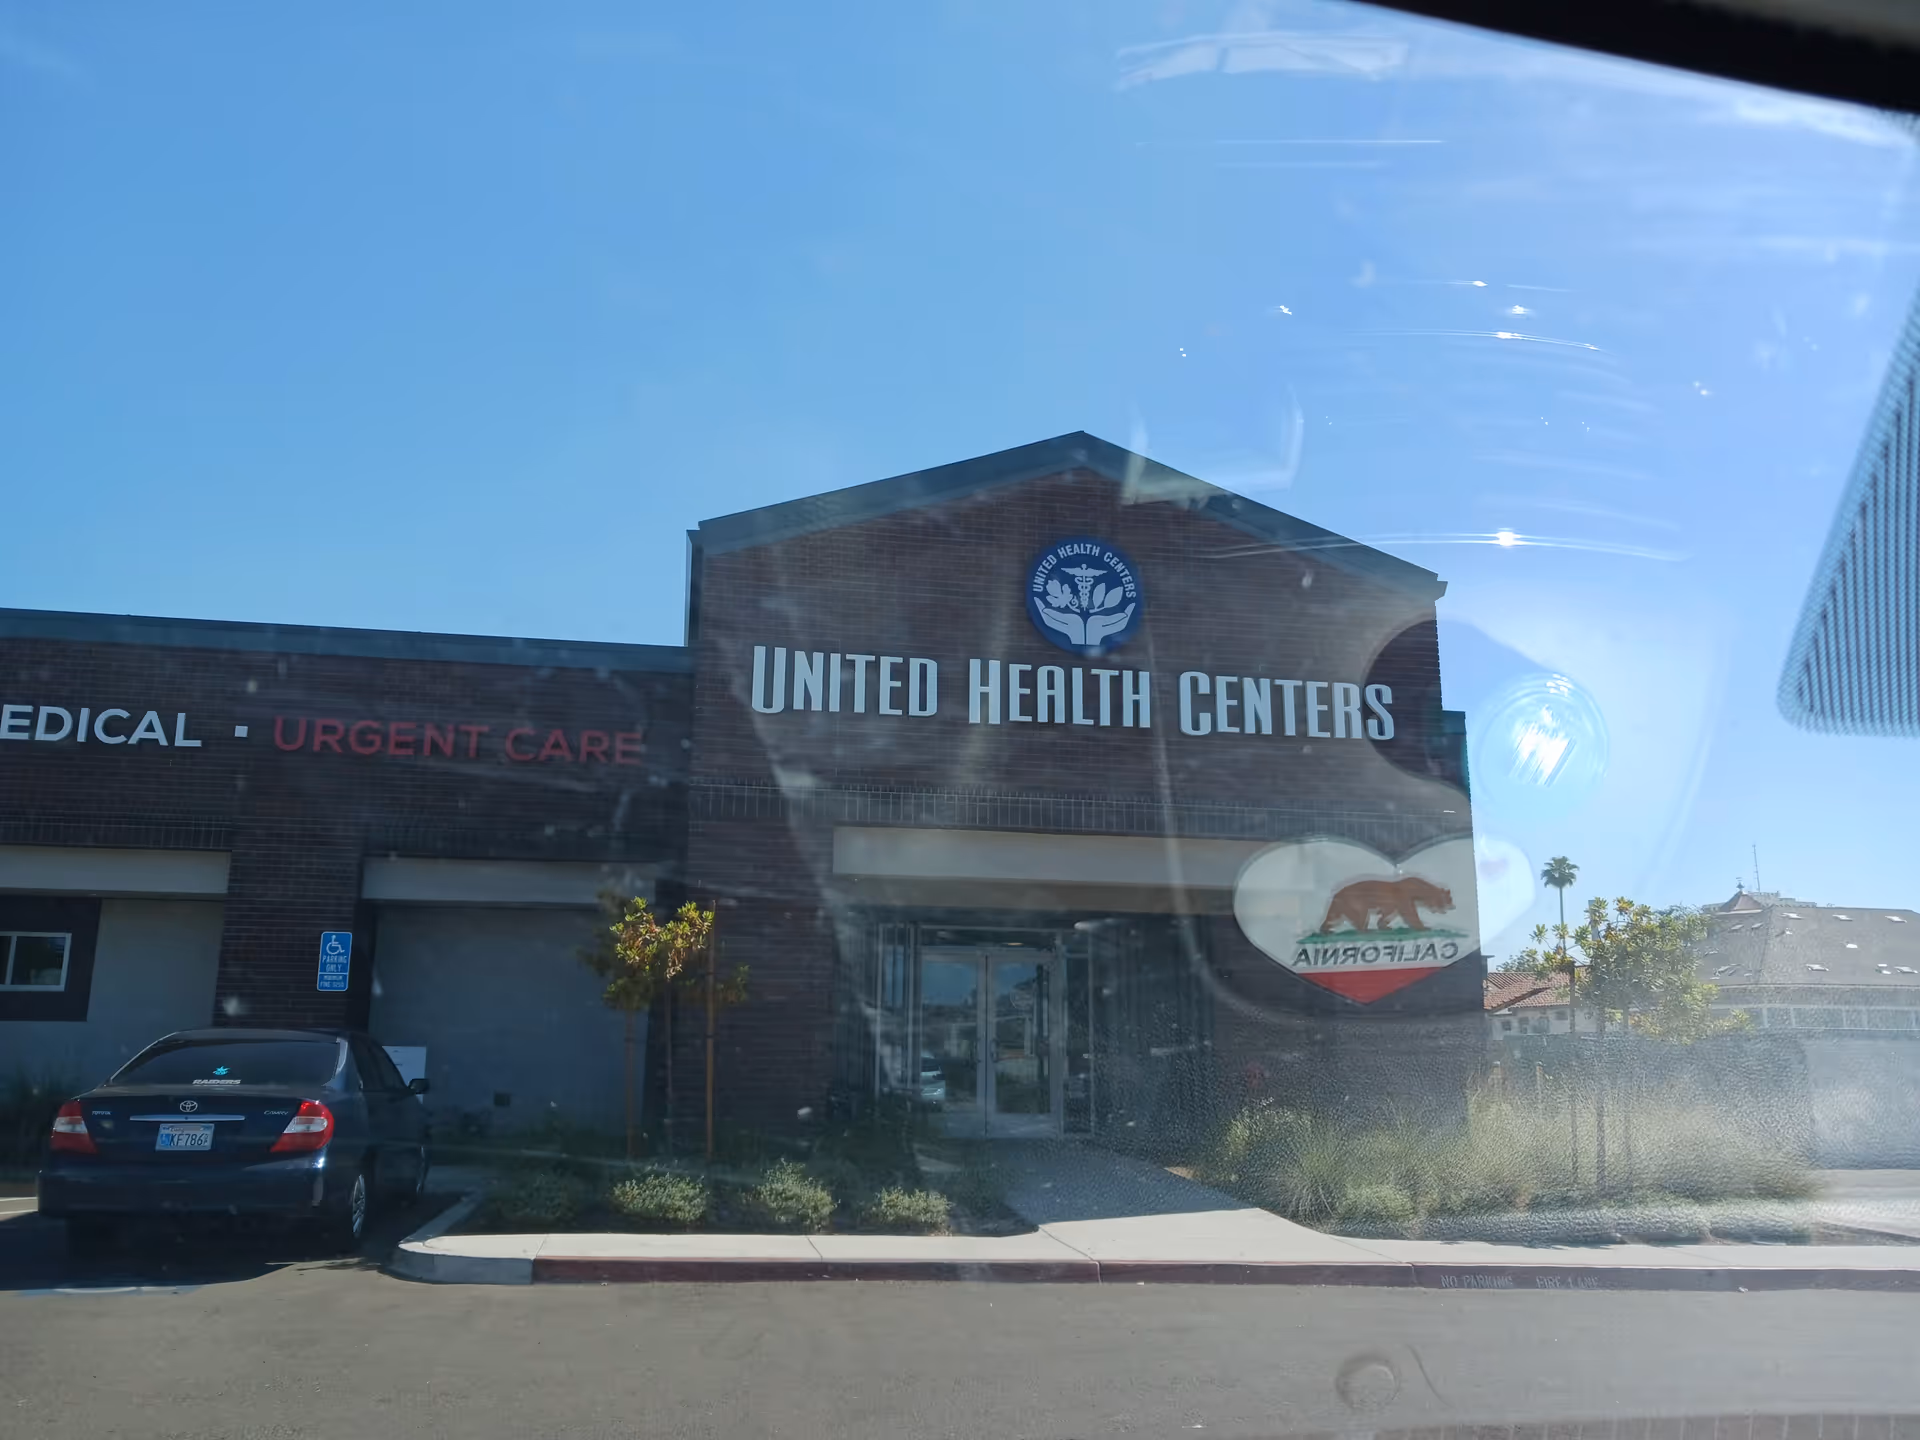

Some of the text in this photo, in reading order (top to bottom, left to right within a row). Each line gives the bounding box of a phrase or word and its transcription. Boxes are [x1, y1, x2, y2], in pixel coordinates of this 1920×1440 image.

[1033, 543, 1136, 598] UNITED HEALTH CENTERS
[751, 645, 1395, 741] UNITED HEALTH CENTERS
[0, 704, 643, 765] EDICAL URGENT CARE
[1441, 1274, 1457, 1288] NO
[1463, 1274, 1513, 1289] PARKING
[1535, 1275, 1561, 1288] FIRE
